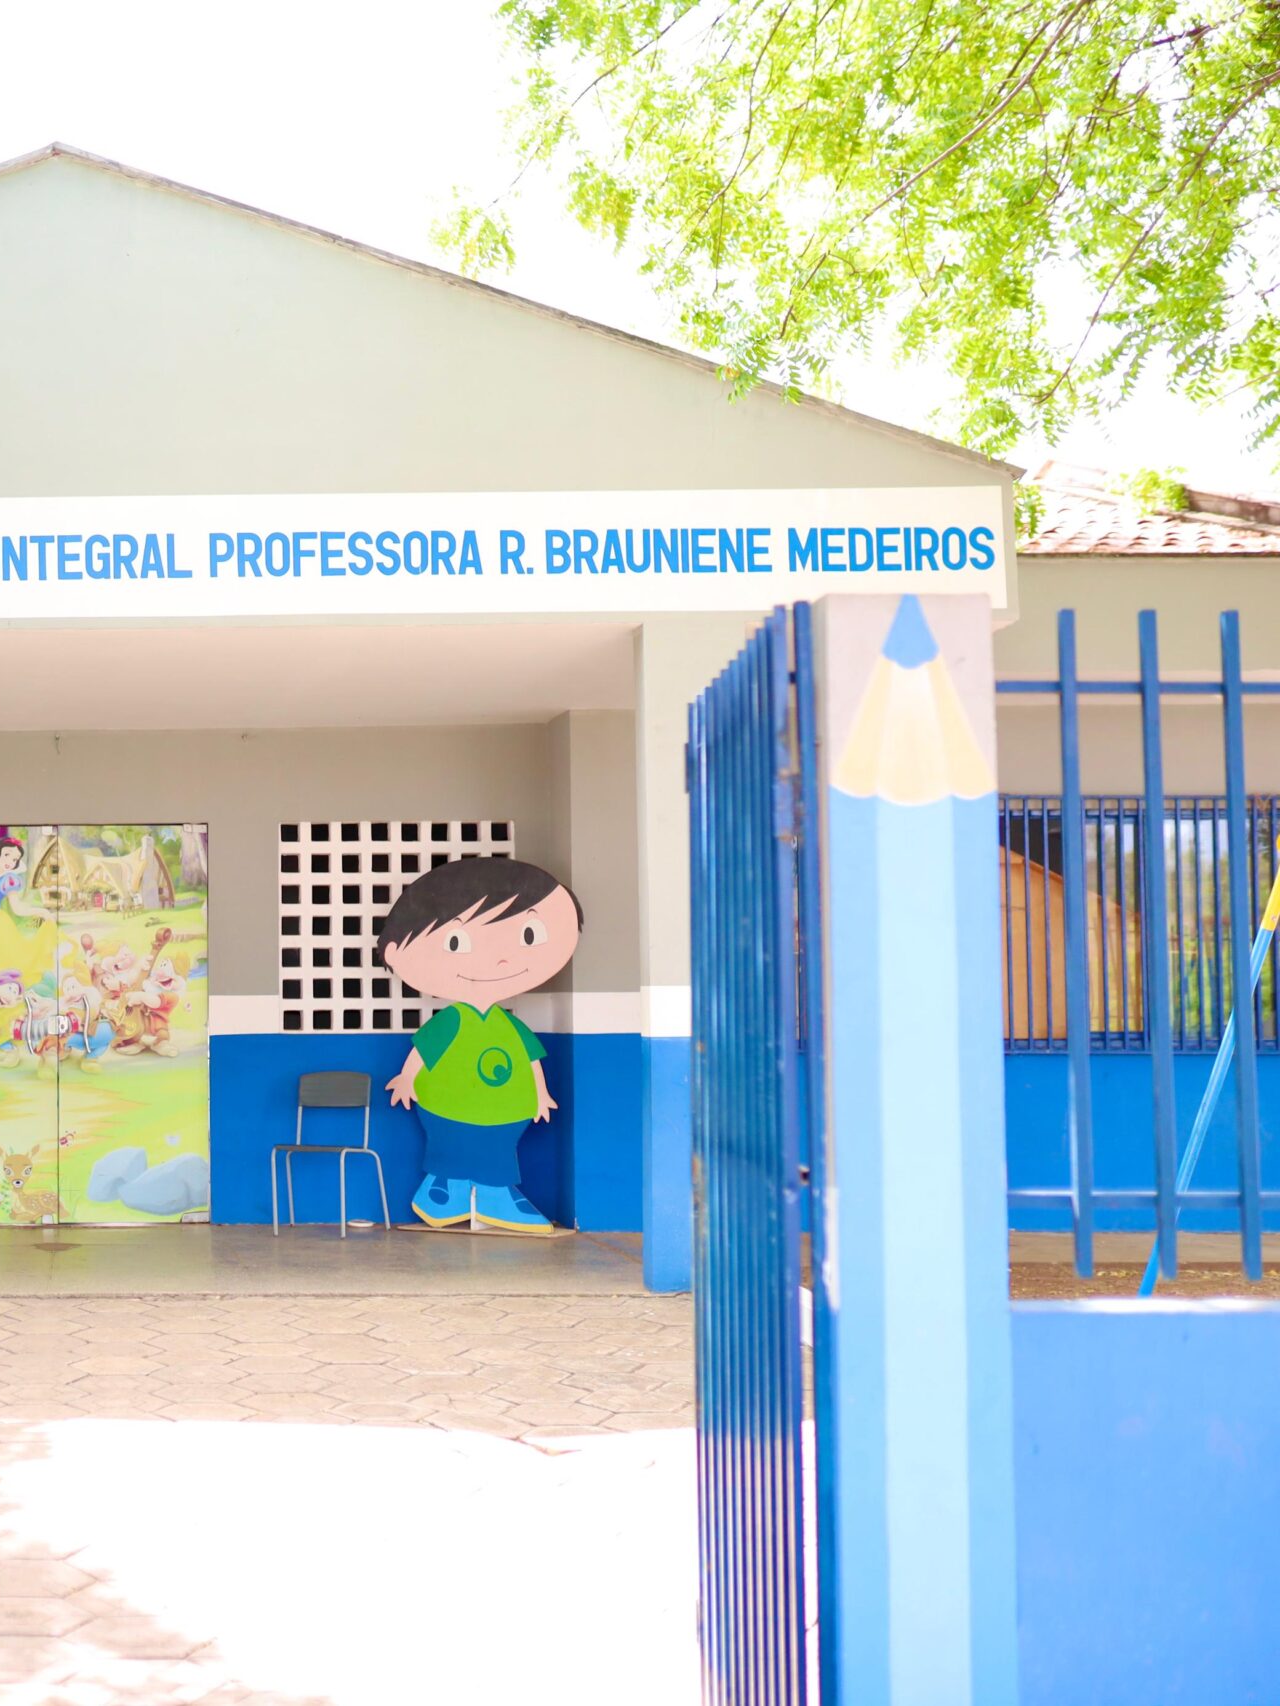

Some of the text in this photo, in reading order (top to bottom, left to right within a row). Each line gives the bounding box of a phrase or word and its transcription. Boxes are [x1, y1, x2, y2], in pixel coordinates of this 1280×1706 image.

[208, 529, 483, 578] PROFESSORA
[499, 529, 535, 575] R.
[544, 527, 773, 574] BRAUNIENE
[787, 525, 996, 573] MEDEIROS
